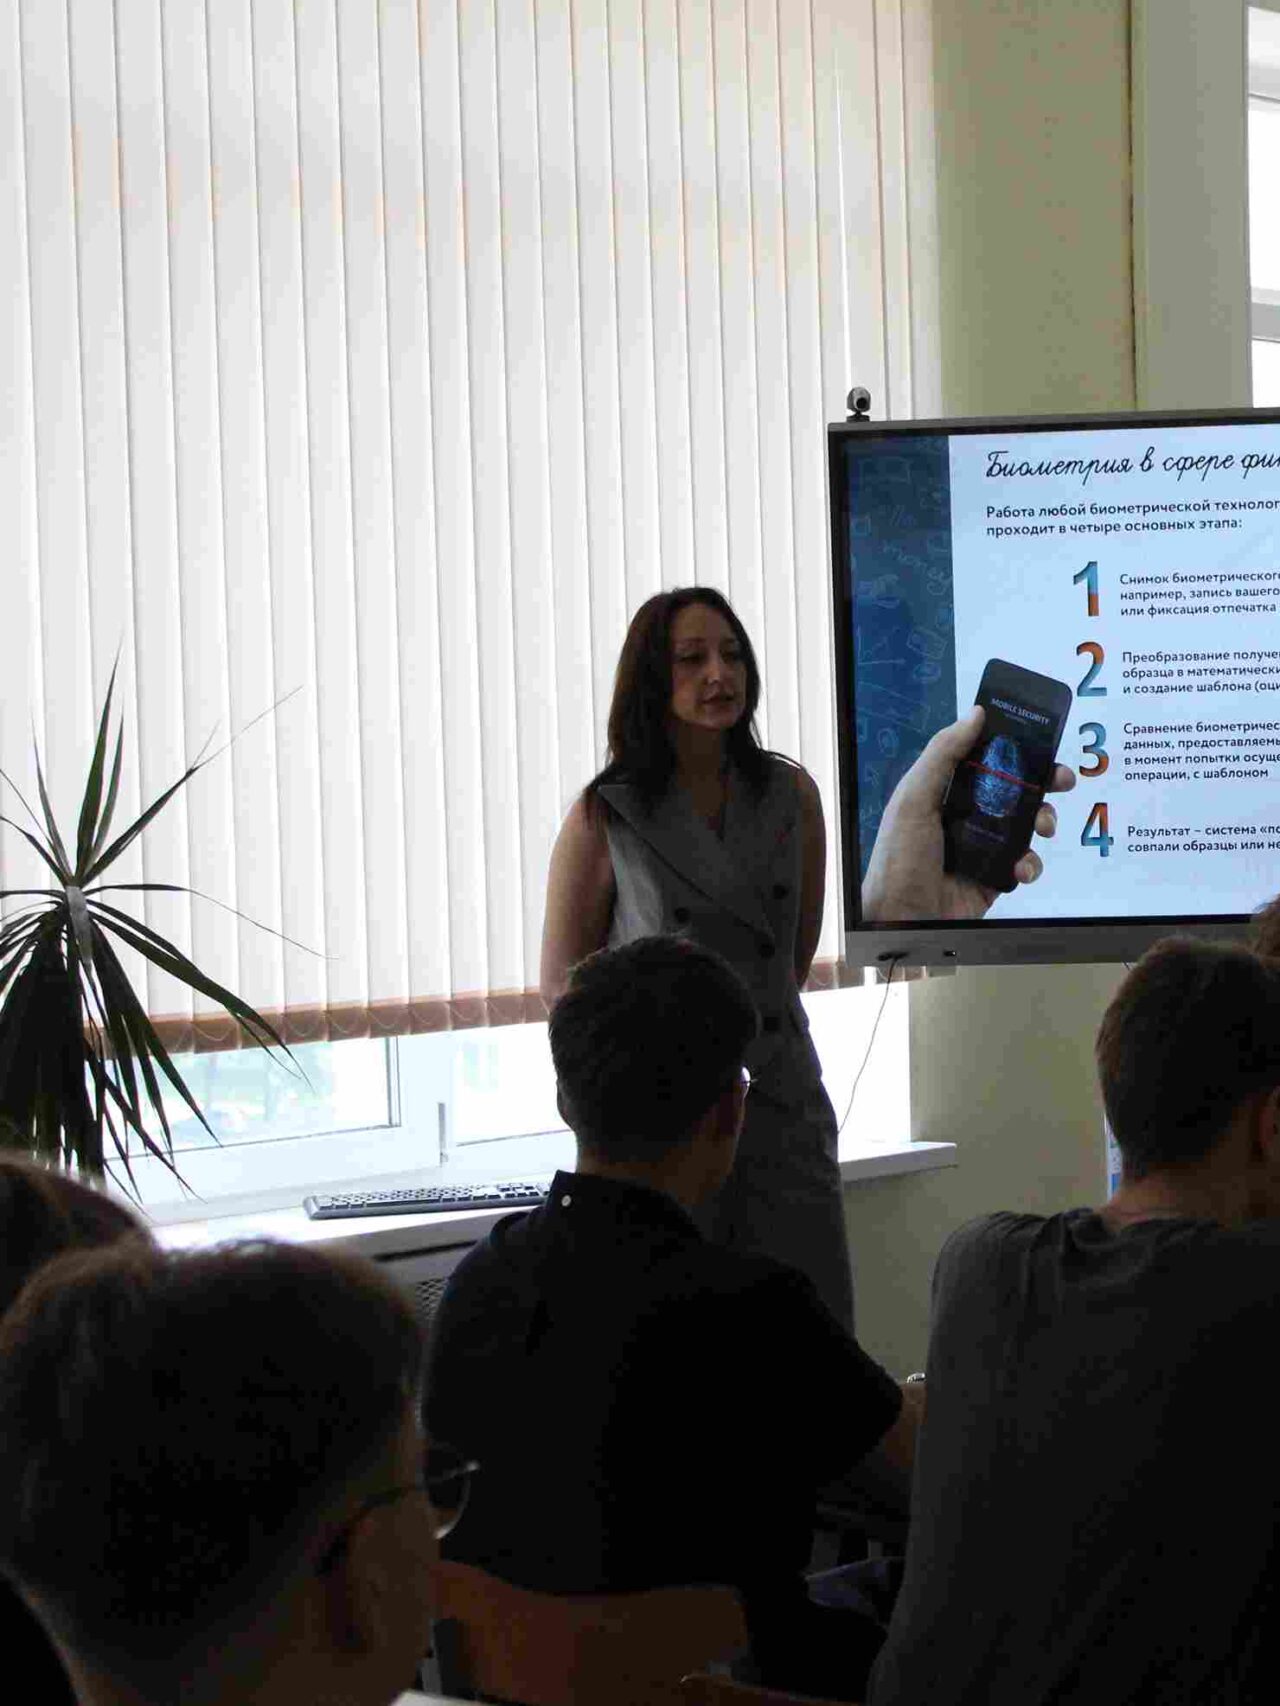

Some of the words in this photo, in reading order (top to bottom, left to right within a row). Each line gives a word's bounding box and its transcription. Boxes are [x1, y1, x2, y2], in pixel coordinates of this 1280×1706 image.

[985, 450, 1134, 485] Биометрия
[1140, 446, 1155, 472] в
[1162, 455, 1235, 483] сфере
[986, 505, 1035, 518] Работа
[1038, 502, 1086, 517] любой
[1089, 500, 1211, 516] биометрической
[986, 523, 1055, 538] проходит
[1058, 524, 1066, 534] в
[1069, 522, 1121, 535] четыре
[1124, 519, 1196, 531] основных
[1199, 518, 1242, 531] этапа:
[1119, 573, 1169, 585] Снимок
[1072, 560, 1099, 618] 1
[1120, 590, 1186, 603] например,
[1189, 588, 1232, 600] запись
[1235, 586, 1280, 598] вашего
[1120, 606, 1145, 616] или
[1148, 602, 1210, 617] фиксация
[1212, 603, 1277, 614] отпечатка
[1122, 649, 1230, 665] Преобразование
[1075, 641, 1108, 697] 2
[1122, 666, 1174, 679] образца
[1177, 668, 1184, 677] в
[1123, 685, 1131, 693] и
[1134, 683, 1194, 695] создание
[1196, 680, 1252, 692] шаблона
[1017, 706, 1050, 725] SECURITY
[1123, 722, 1193, 735] Сравнение
[1078, 722, 1109, 778] 3
[1123, 739, 1175, 751] данных,
[1124, 756, 1132, 765] в
[1135, 754, 1183, 765] момент
[1185, 752, 1241, 764] попытки
[1124, 769, 1191, 783] операции,
[1193, 770, 1201, 779] с
[1203, 766, 1268, 780] шаблоном
[1080, 802, 1115, 857] 4
[1127, 824, 1191, 839] Результат
[1205, 824, 1257, 836] система
[1127, 840, 1180, 852] совпали
[1182, 839, 1237, 852] образцы
[1240, 839, 1265, 850] или
